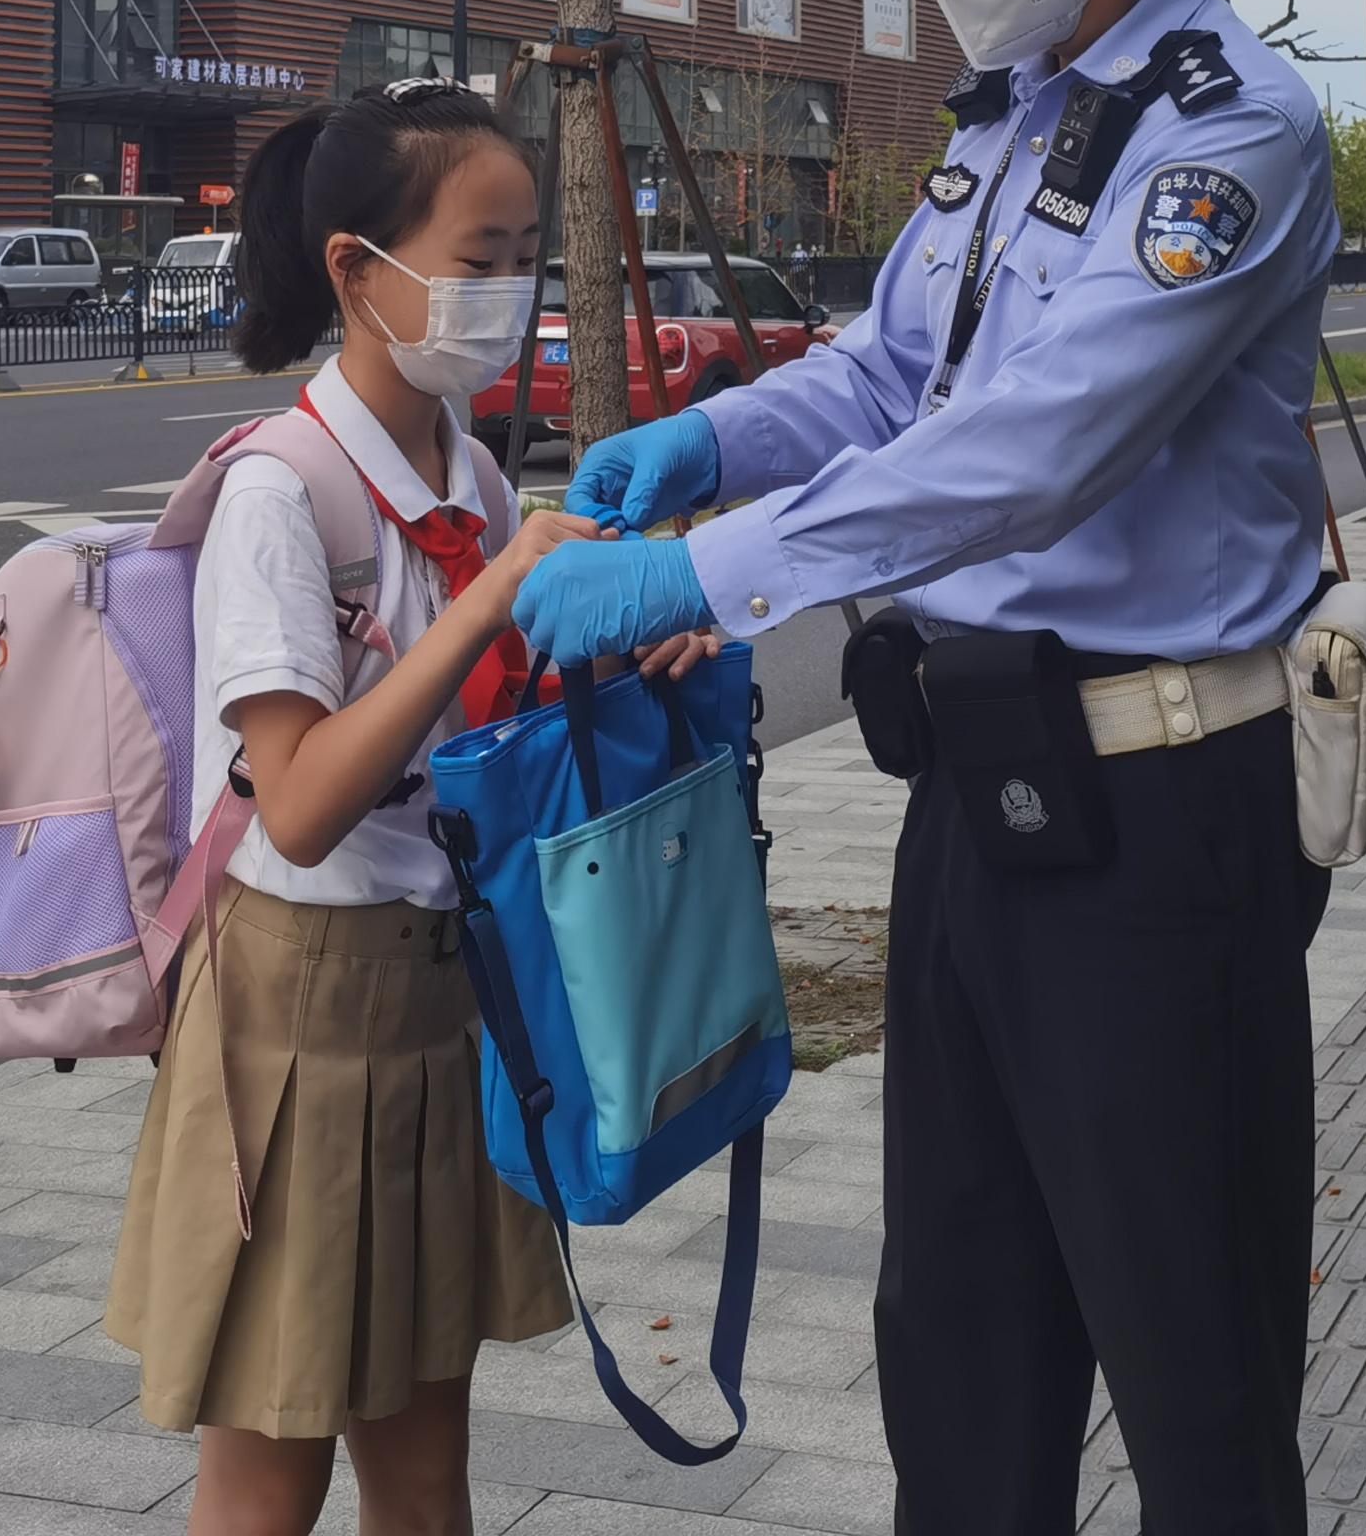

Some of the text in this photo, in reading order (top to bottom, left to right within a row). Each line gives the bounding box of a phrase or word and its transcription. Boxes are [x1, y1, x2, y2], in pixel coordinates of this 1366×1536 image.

[154, 55, 305, 91] 可家建材家居品牌中心
[640, 192, 653, 207] P
[1036, 187, 1090, 227] 056260
[1157, 172, 1253, 222] 中华人民共和国
[966, 230, 983, 277] POLICE
